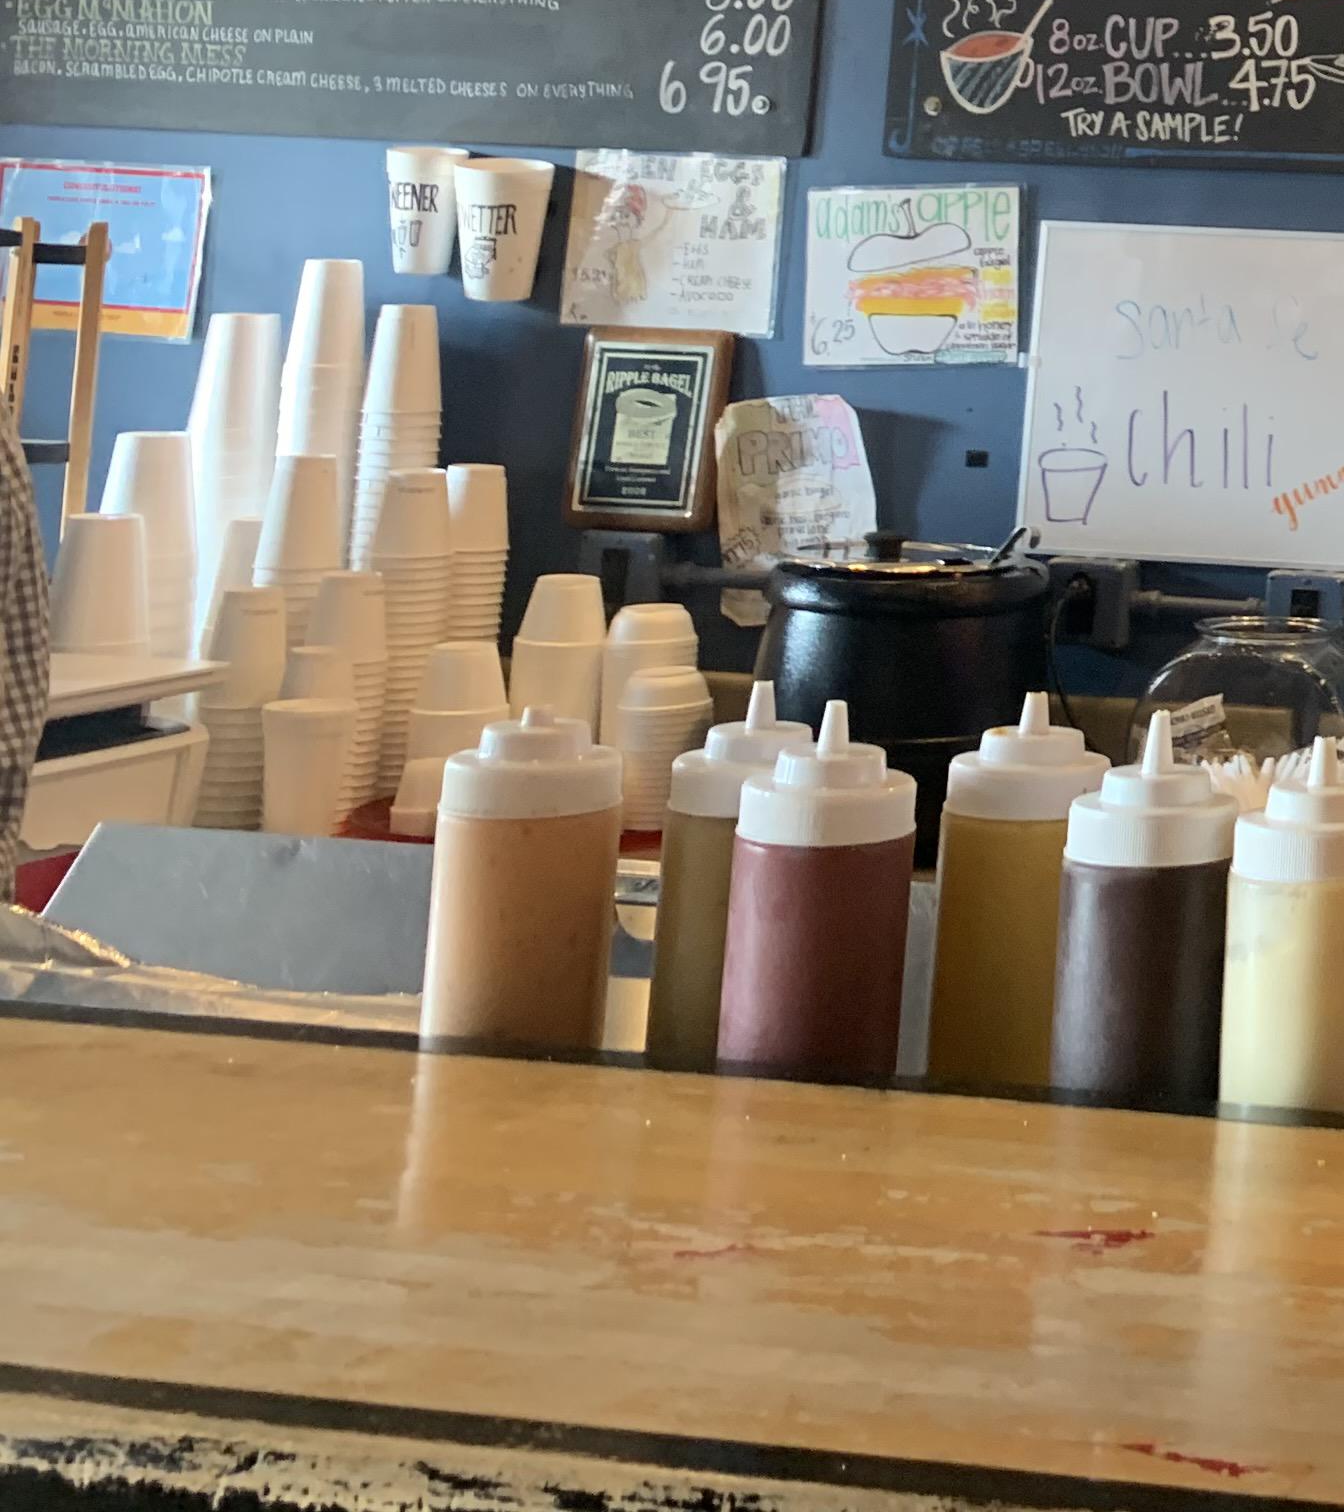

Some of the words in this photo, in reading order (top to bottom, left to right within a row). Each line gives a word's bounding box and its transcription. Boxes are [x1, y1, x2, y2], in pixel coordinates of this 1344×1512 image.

[1061, 110, 1105, 138] TRY
[1109, 113, 1131, 138] A
[1137, 113, 1243, 144] SAMPLE!
